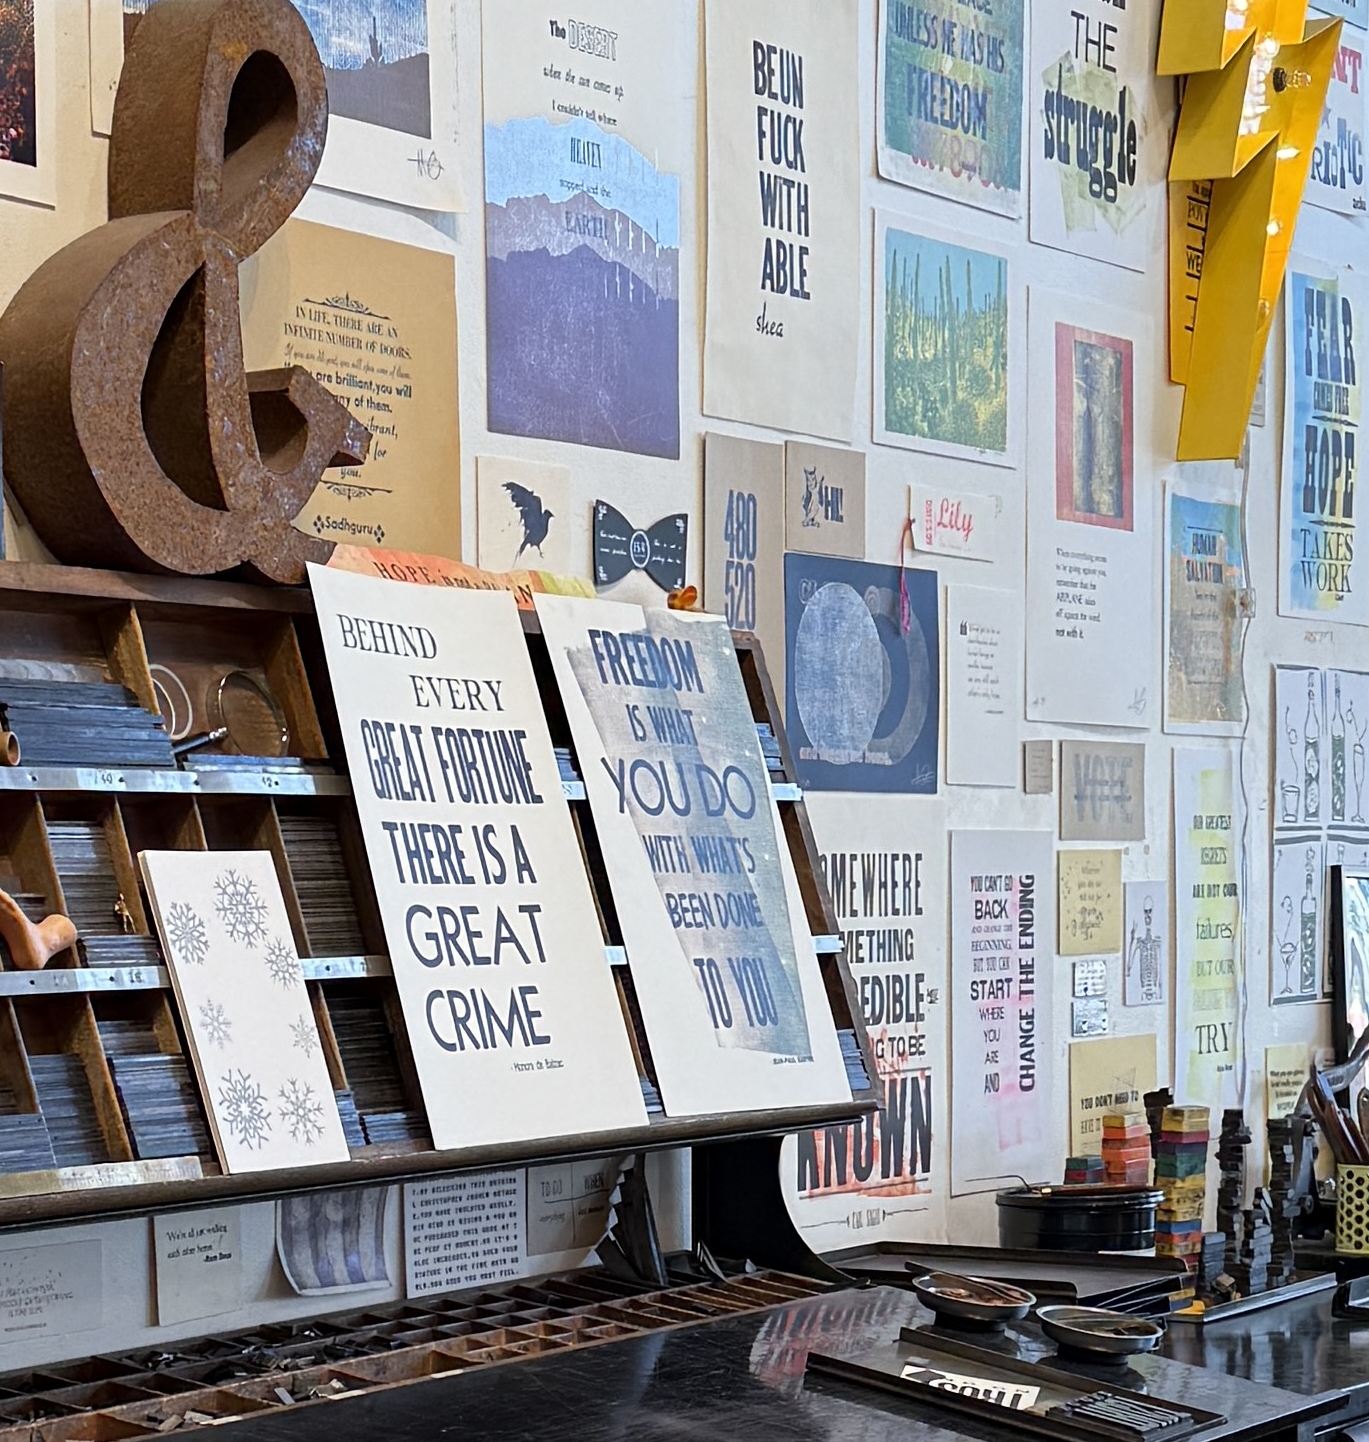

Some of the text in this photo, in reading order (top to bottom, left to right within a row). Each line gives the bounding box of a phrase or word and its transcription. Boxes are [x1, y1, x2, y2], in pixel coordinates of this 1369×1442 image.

[1071, 11, 1118, 73] THE
[757, 107, 805, 172] FUCK
[1043, 63, 1136, 204] struggle
[759, 172, 809, 237] WITH
[761, 237, 811, 300] ABLE
[756, 303, 784, 339] shea
[1303, 287, 1357, 384] FEAR
[1302, 425, 1356, 518] HOPE
[325, 515, 375, 536] Sadhguru
[724, 490, 757, 560] 480
[936, 499, 974, 538] Lily
[1301, 528, 1354, 563] TAKES
[724, 561, 756, 631] 520
[1301, 559, 1353, 594] WORK
[335, 614, 438, 660] BEHIND
[587, 629, 705, 693] FREEDOM
[408, 675, 503, 712] EVERY
[625, 705, 699, 746] IS WHAT
[361, 718, 543, 805] GREAT FORTUNE
[600, 757, 756, 820] YOU DO
[642, 835, 756, 873] WITH WHAT'S
[406, 904, 547, 967] GREAT
[665, 891, 762, 929] BEEN DONE
[974, 898, 1009, 920] BACK
[693, 958, 778, 1029] TO YOU
[970, 979, 1012, 1001] START
[1019, 875, 1035, 1093] CHANGE THE ENDING
[426, 986, 551, 1053] CRIME
[1195, 1023, 1235, 1055] TRY
